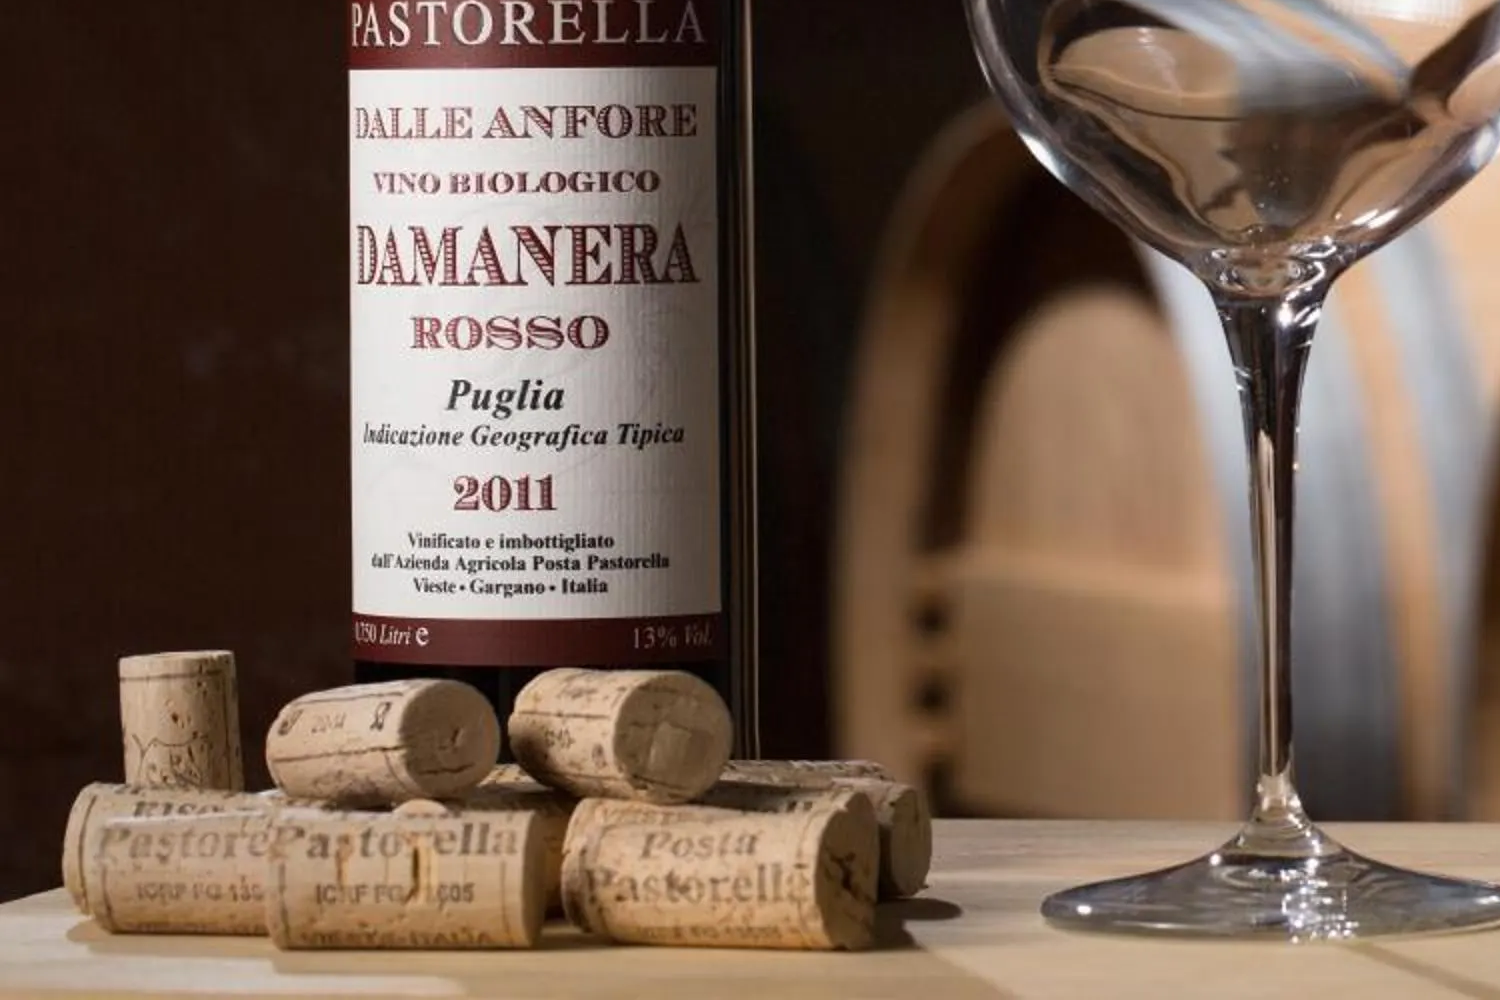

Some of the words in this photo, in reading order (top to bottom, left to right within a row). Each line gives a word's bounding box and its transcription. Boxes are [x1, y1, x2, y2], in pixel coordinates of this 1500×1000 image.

[351, 0, 706, 48] PASTORELLA
[355, 105, 473, 139] DALLE
[482, 103, 698, 140] ANFORE
[373, 171, 441, 194] VINO
[449, 169, 661, 194] BIOLOGICO
[356, 224, 701, 287] DAMANERA
[410, 314, 611, 351] ROSSO
[445, 378, 566, 420] Puglia
[363, 422, 465, 447] Indicazione
[471, 422, 608, 452] Geografica
[616, 422, 685, 451] Tipica
[453, 474, 558, 512] 2011
[408, 532, 481, 550] Vinificato
[485, 536, 495, 550] e
[499, 532, 616, 553] imbottigliato
[371, 553, 450, 571] dall'Azienda
[455, 554, 526, 575] Agricola
[532, 555, 581, 571] Posta
[587, 553, 670, 570] Pastorella
[413, 577, 457, 594] Vieste
[470, 578, 546, 598] Gargano
[561, 577, 609, 595] Italia
[379, 623, 412, 645] Litri
[634, 625, 678, 649] 13%
[640, 829, 762, 860] Posta
[586, 862, 811, 905] Pastorella
